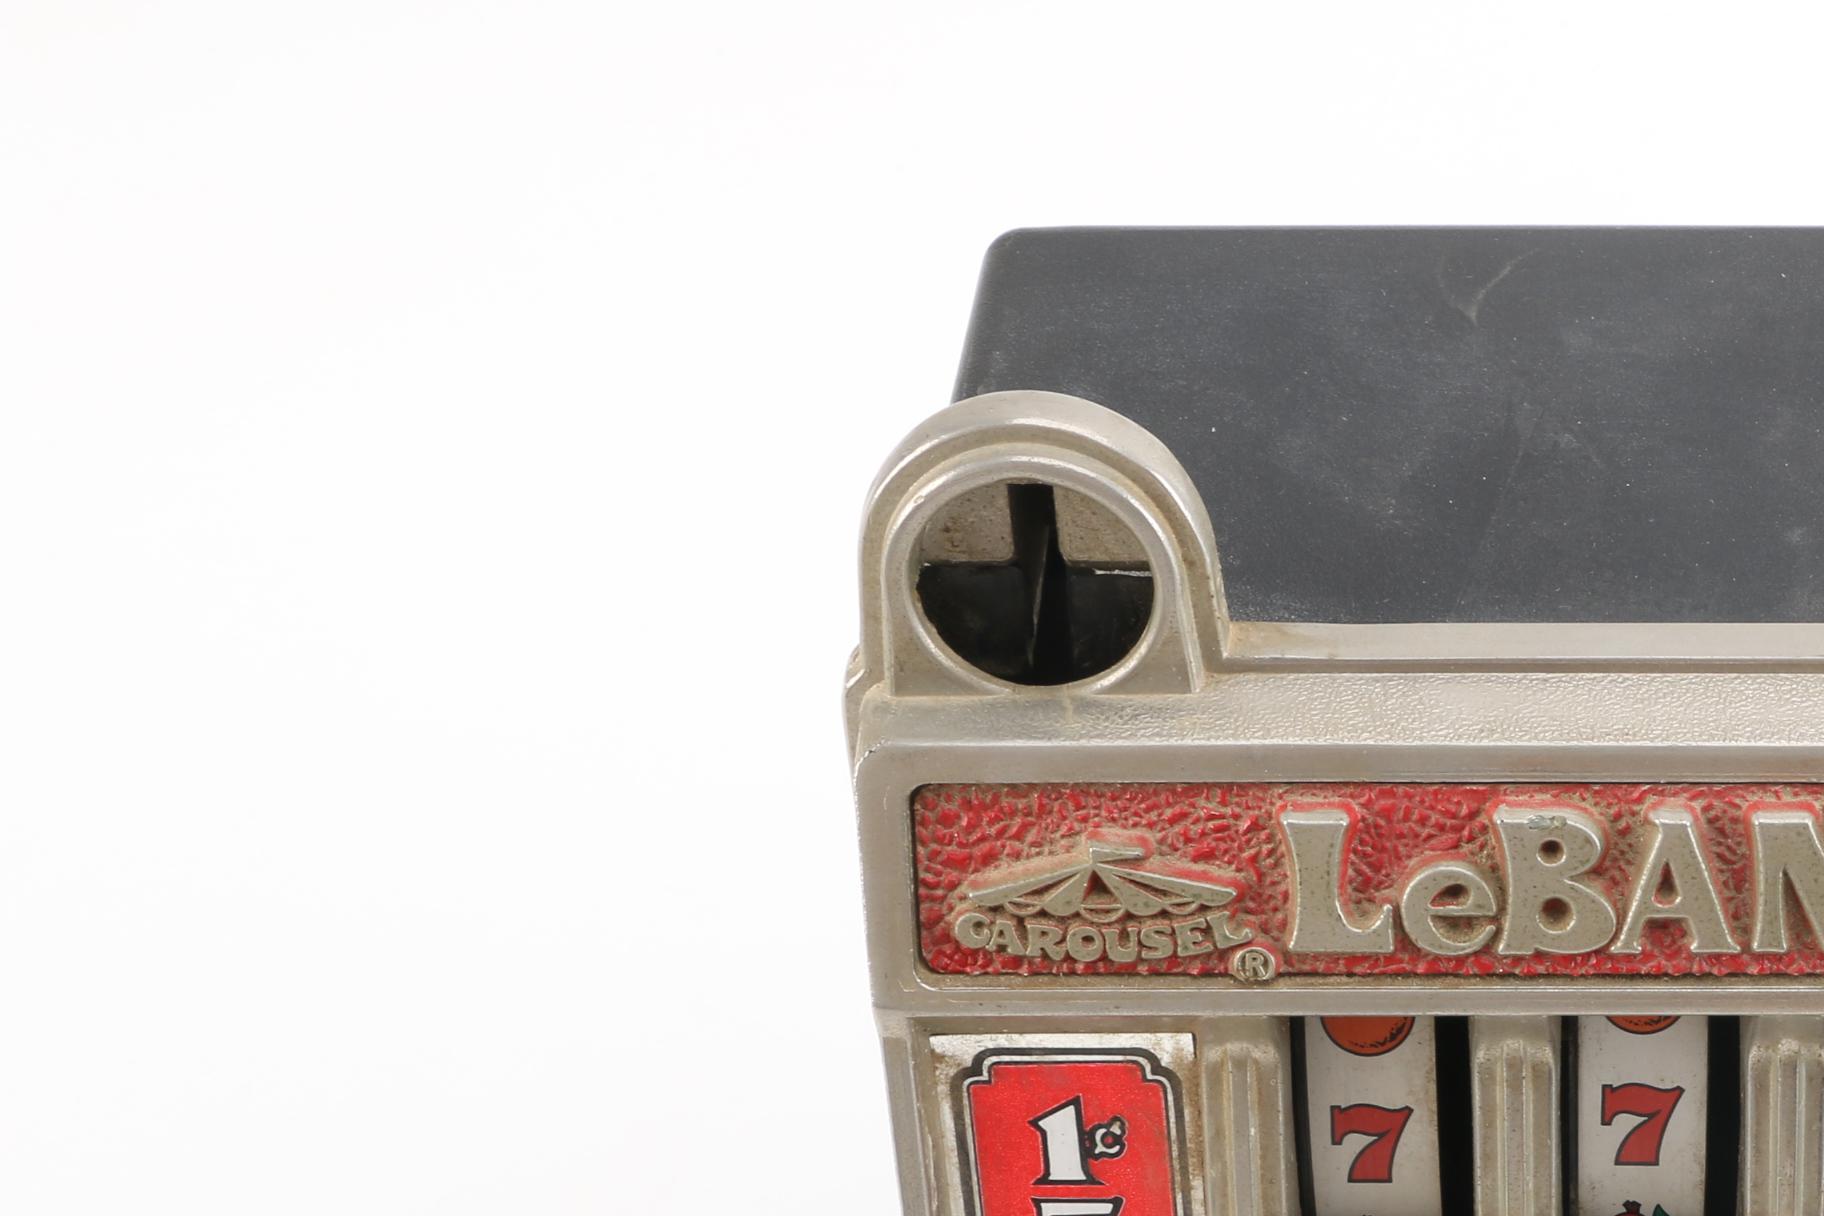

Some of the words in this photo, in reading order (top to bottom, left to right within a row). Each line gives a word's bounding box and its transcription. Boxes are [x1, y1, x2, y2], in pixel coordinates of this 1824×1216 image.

[954, 911, 1253, 963] CAROUSEL
[1330, 1102, 1415, 1183] 7
[1600, 1082, 1685, 1166] 7
